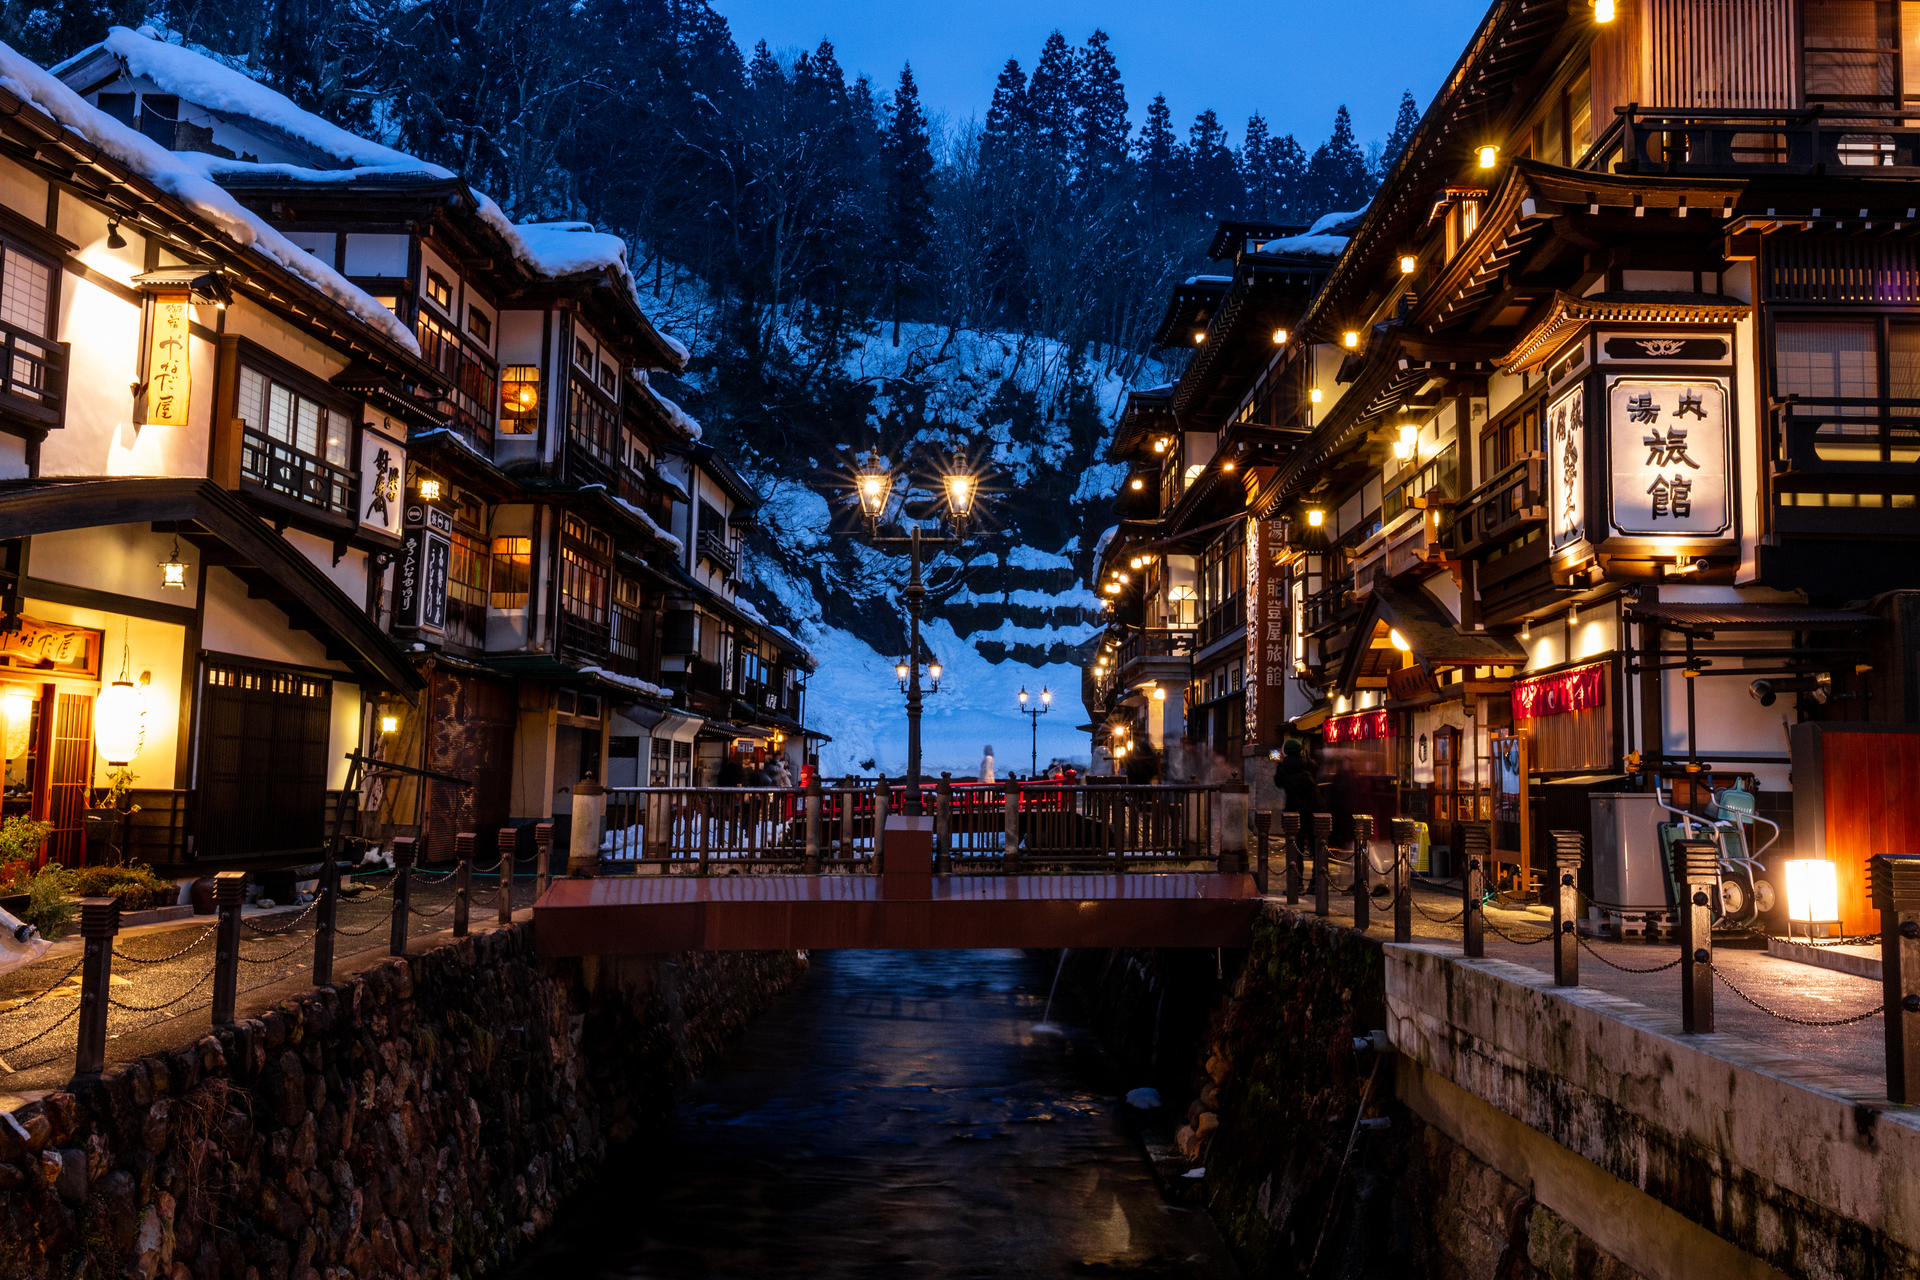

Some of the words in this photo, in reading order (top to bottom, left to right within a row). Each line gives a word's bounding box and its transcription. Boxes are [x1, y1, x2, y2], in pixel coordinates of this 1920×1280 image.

[1643, 425, 1701, 520] 旅館
[1266, 577, 1283, 686] 能登屋旅館
